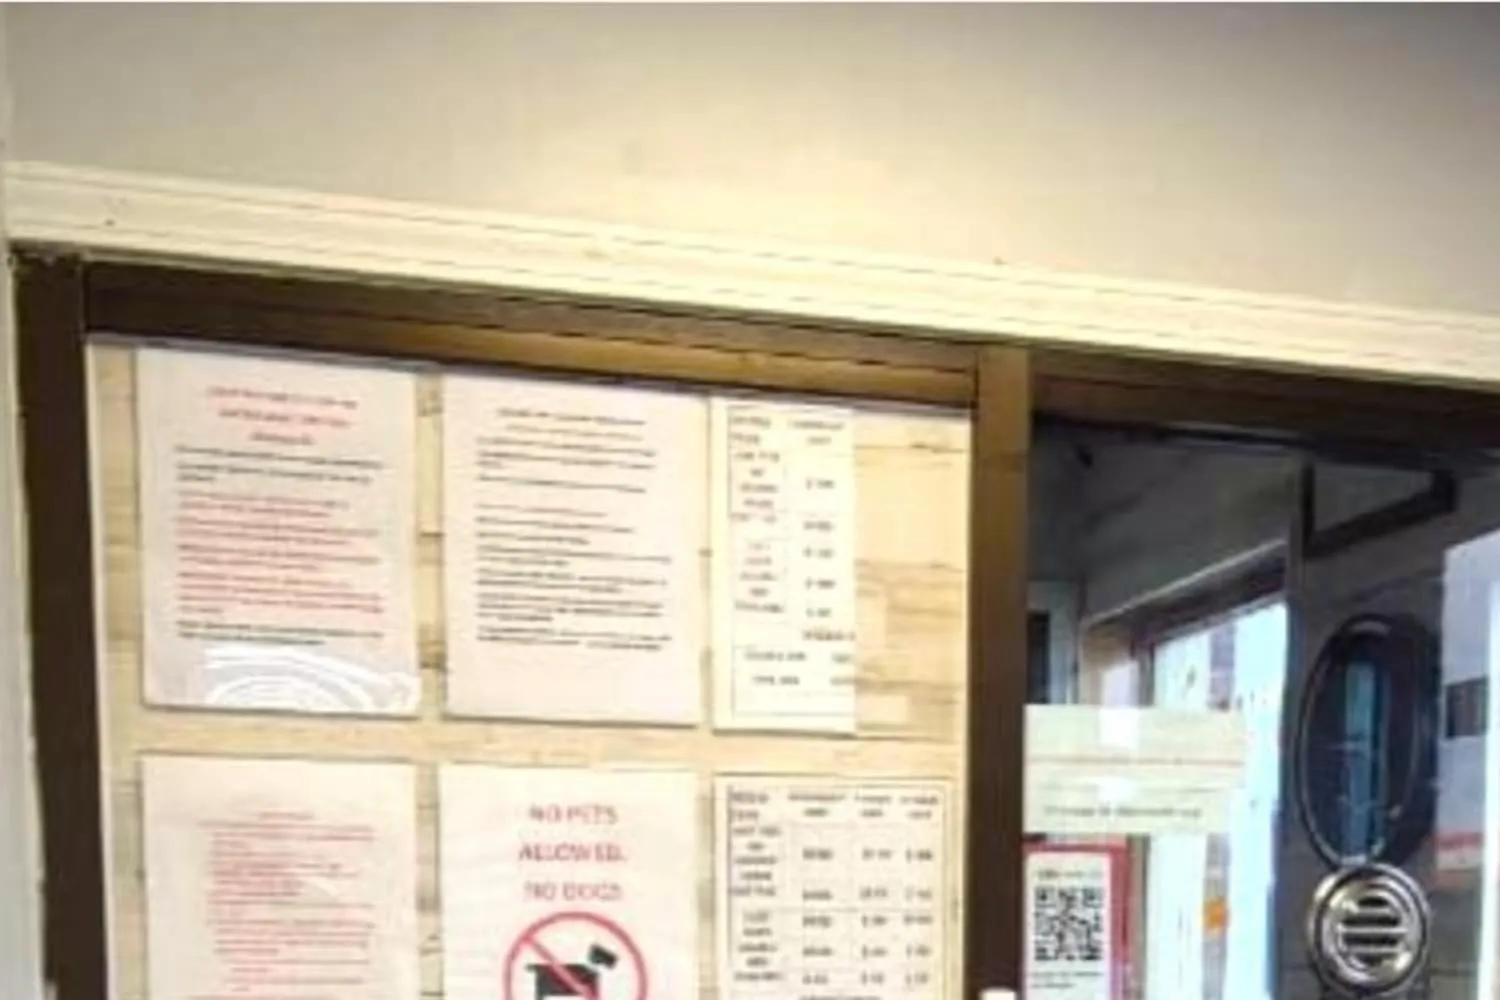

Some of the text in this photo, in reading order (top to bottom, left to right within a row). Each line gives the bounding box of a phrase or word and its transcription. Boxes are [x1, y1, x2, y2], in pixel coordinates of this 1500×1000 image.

[528, 803, 619, 826] NO PETS
[523, 880, 622, 901] NO DOGS
